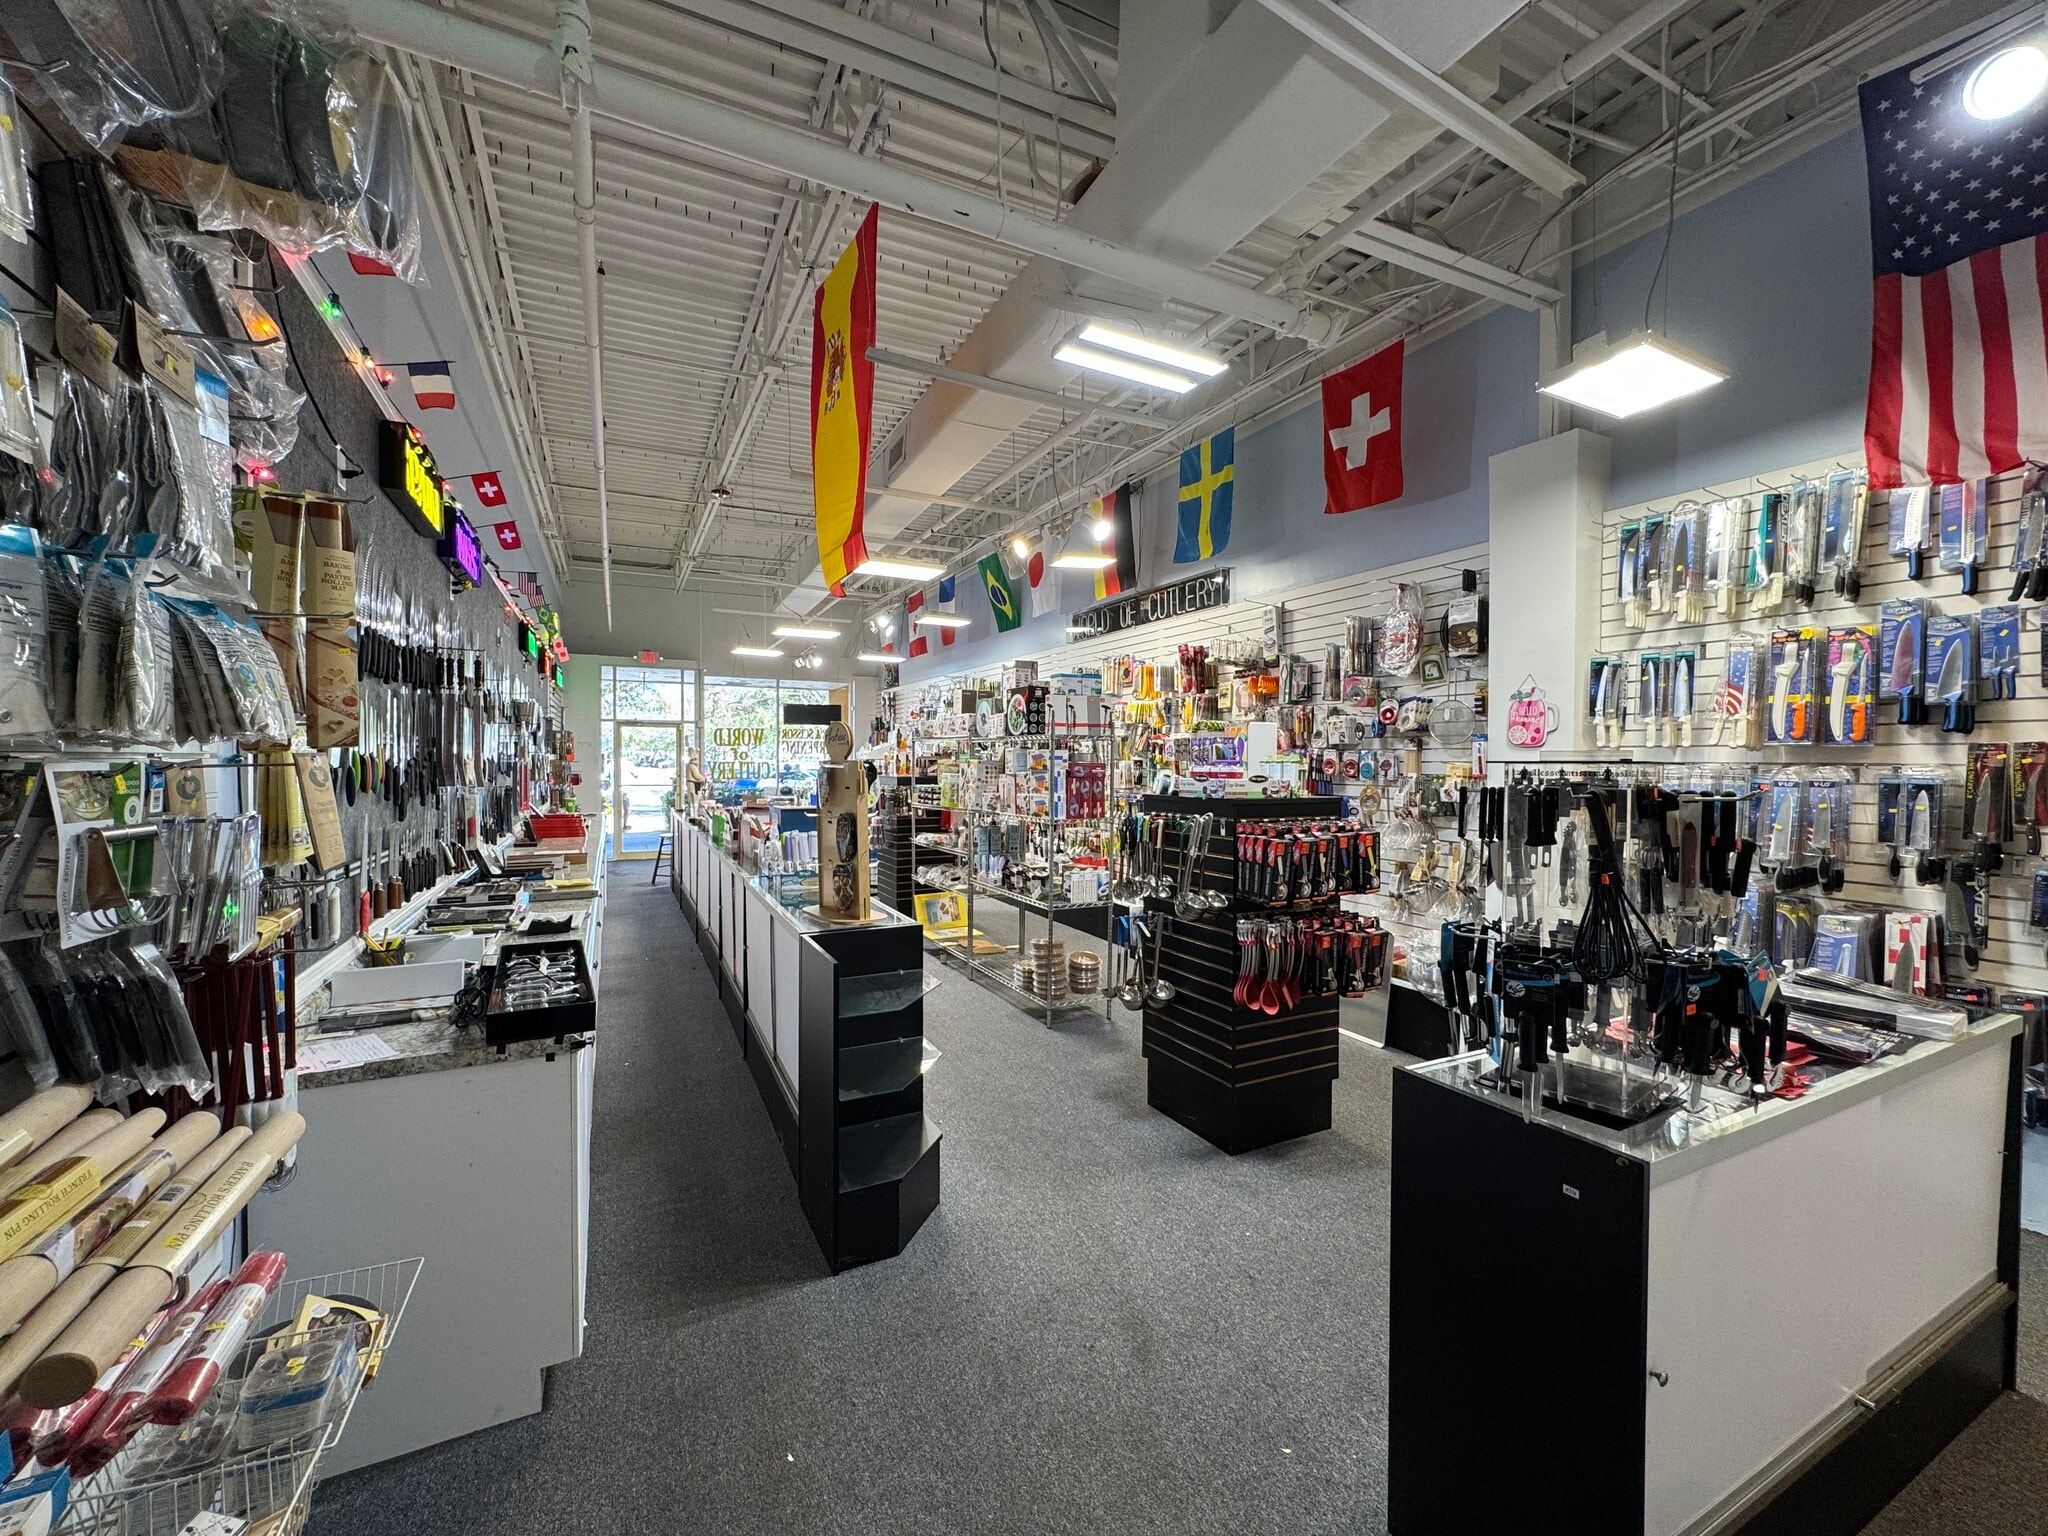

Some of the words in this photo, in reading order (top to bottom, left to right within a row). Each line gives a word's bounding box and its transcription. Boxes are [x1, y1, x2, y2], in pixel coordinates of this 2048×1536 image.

[1781, 494, 1790, 544] DEXTER
[323, 561, 351, 570] BAKING
[324, 572, 352, 581] PASTRY
[321, 578, 354, 587] ROLLING
[1148, 578, 1217, 621] CUTLERY
[63, 847, 71, 883] BLENDER
[60, 1169, 93, 1198] FRENCH
[22, 1194, 61, 1224] ROLLING
[184, 1193, 226, 1232] ROLLING
[4, 1222, 22, 1240] PIN
